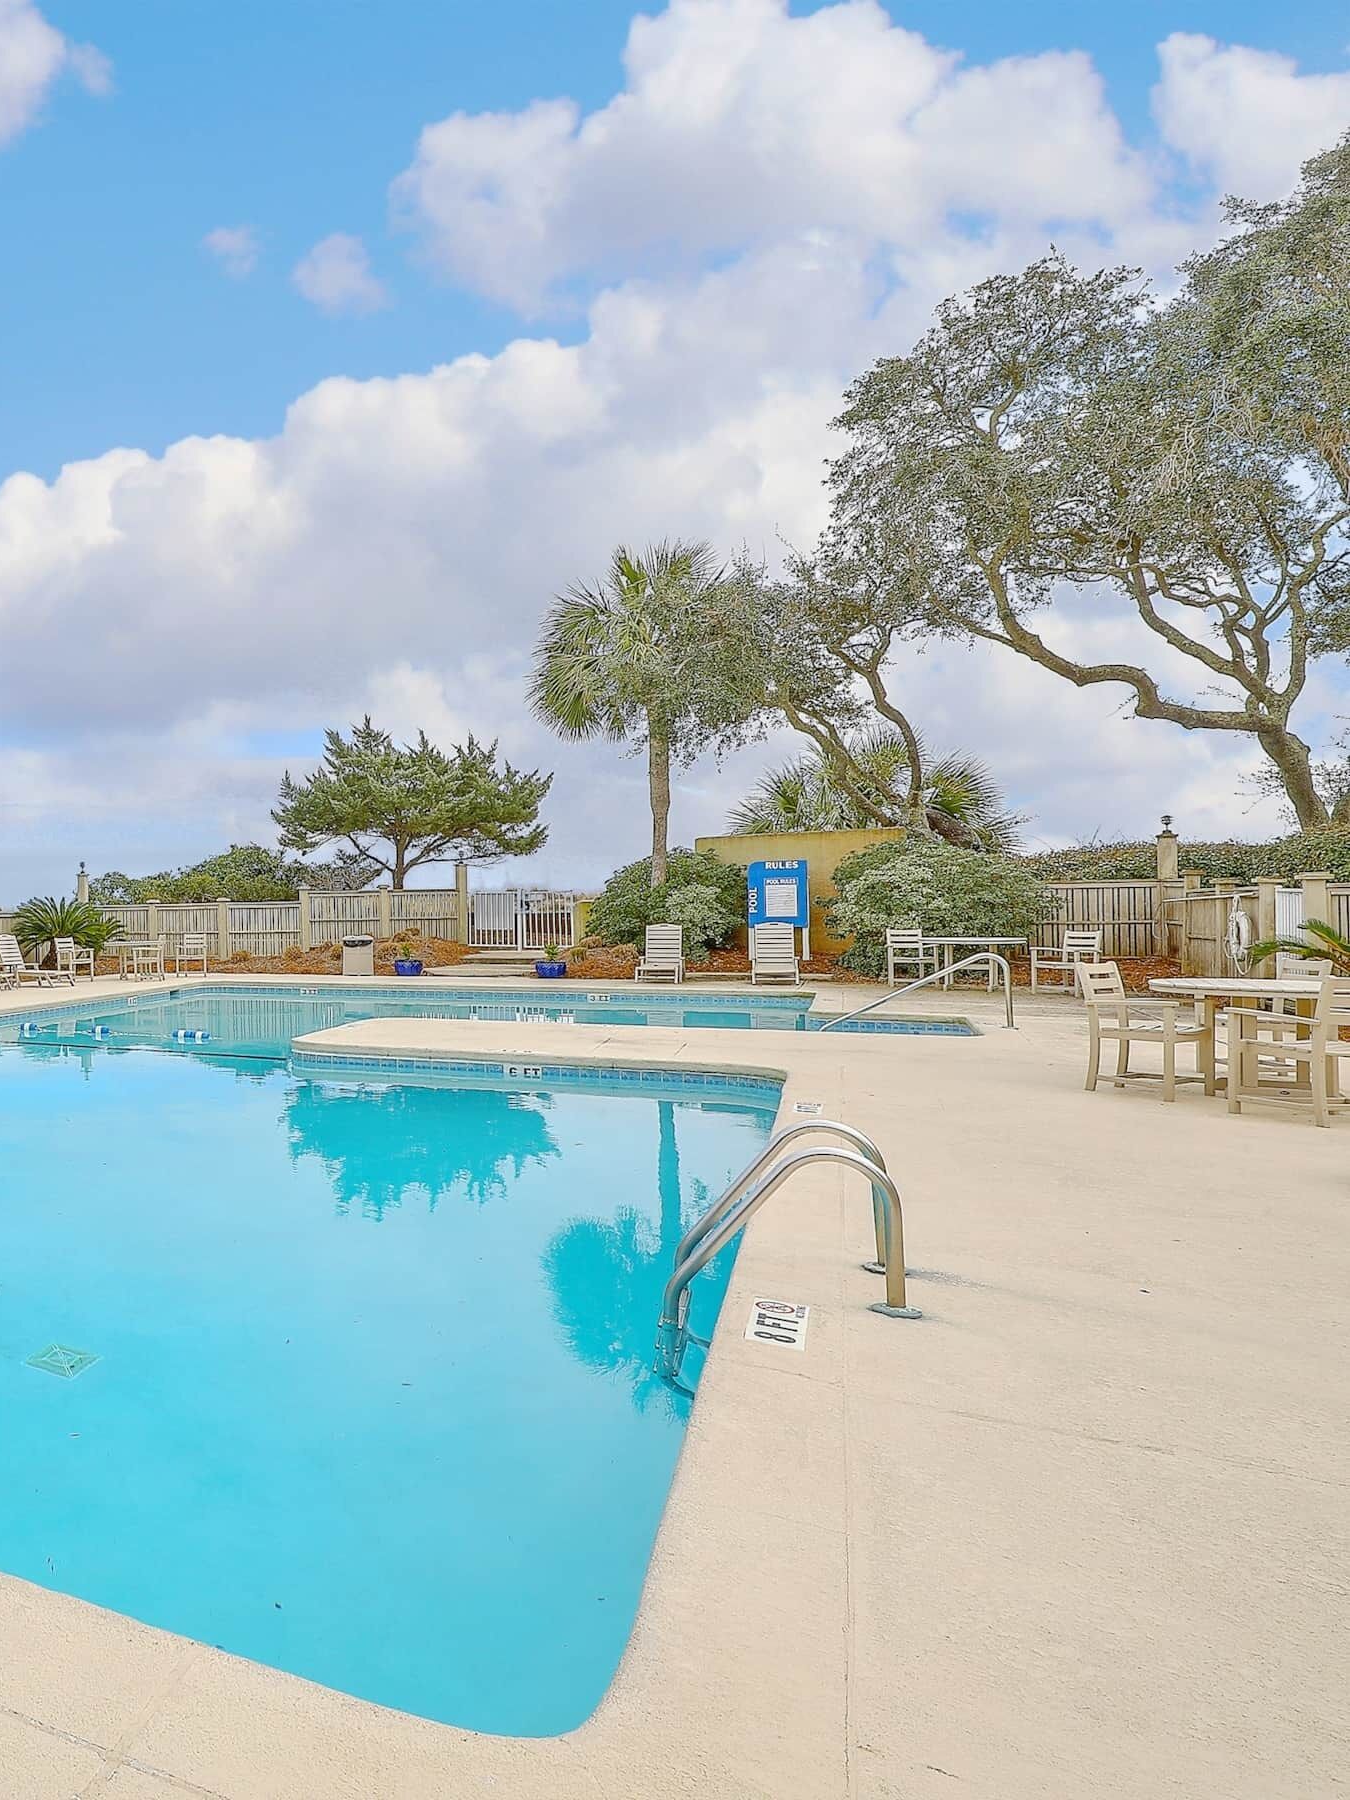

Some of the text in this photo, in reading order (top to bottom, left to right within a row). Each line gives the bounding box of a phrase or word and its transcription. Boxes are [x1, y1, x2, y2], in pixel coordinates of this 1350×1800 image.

[765, 861, 799, 870] RULES
[748, 887, 758, 914] POOL
[754, 1313, 799, 1343] 8 FT
